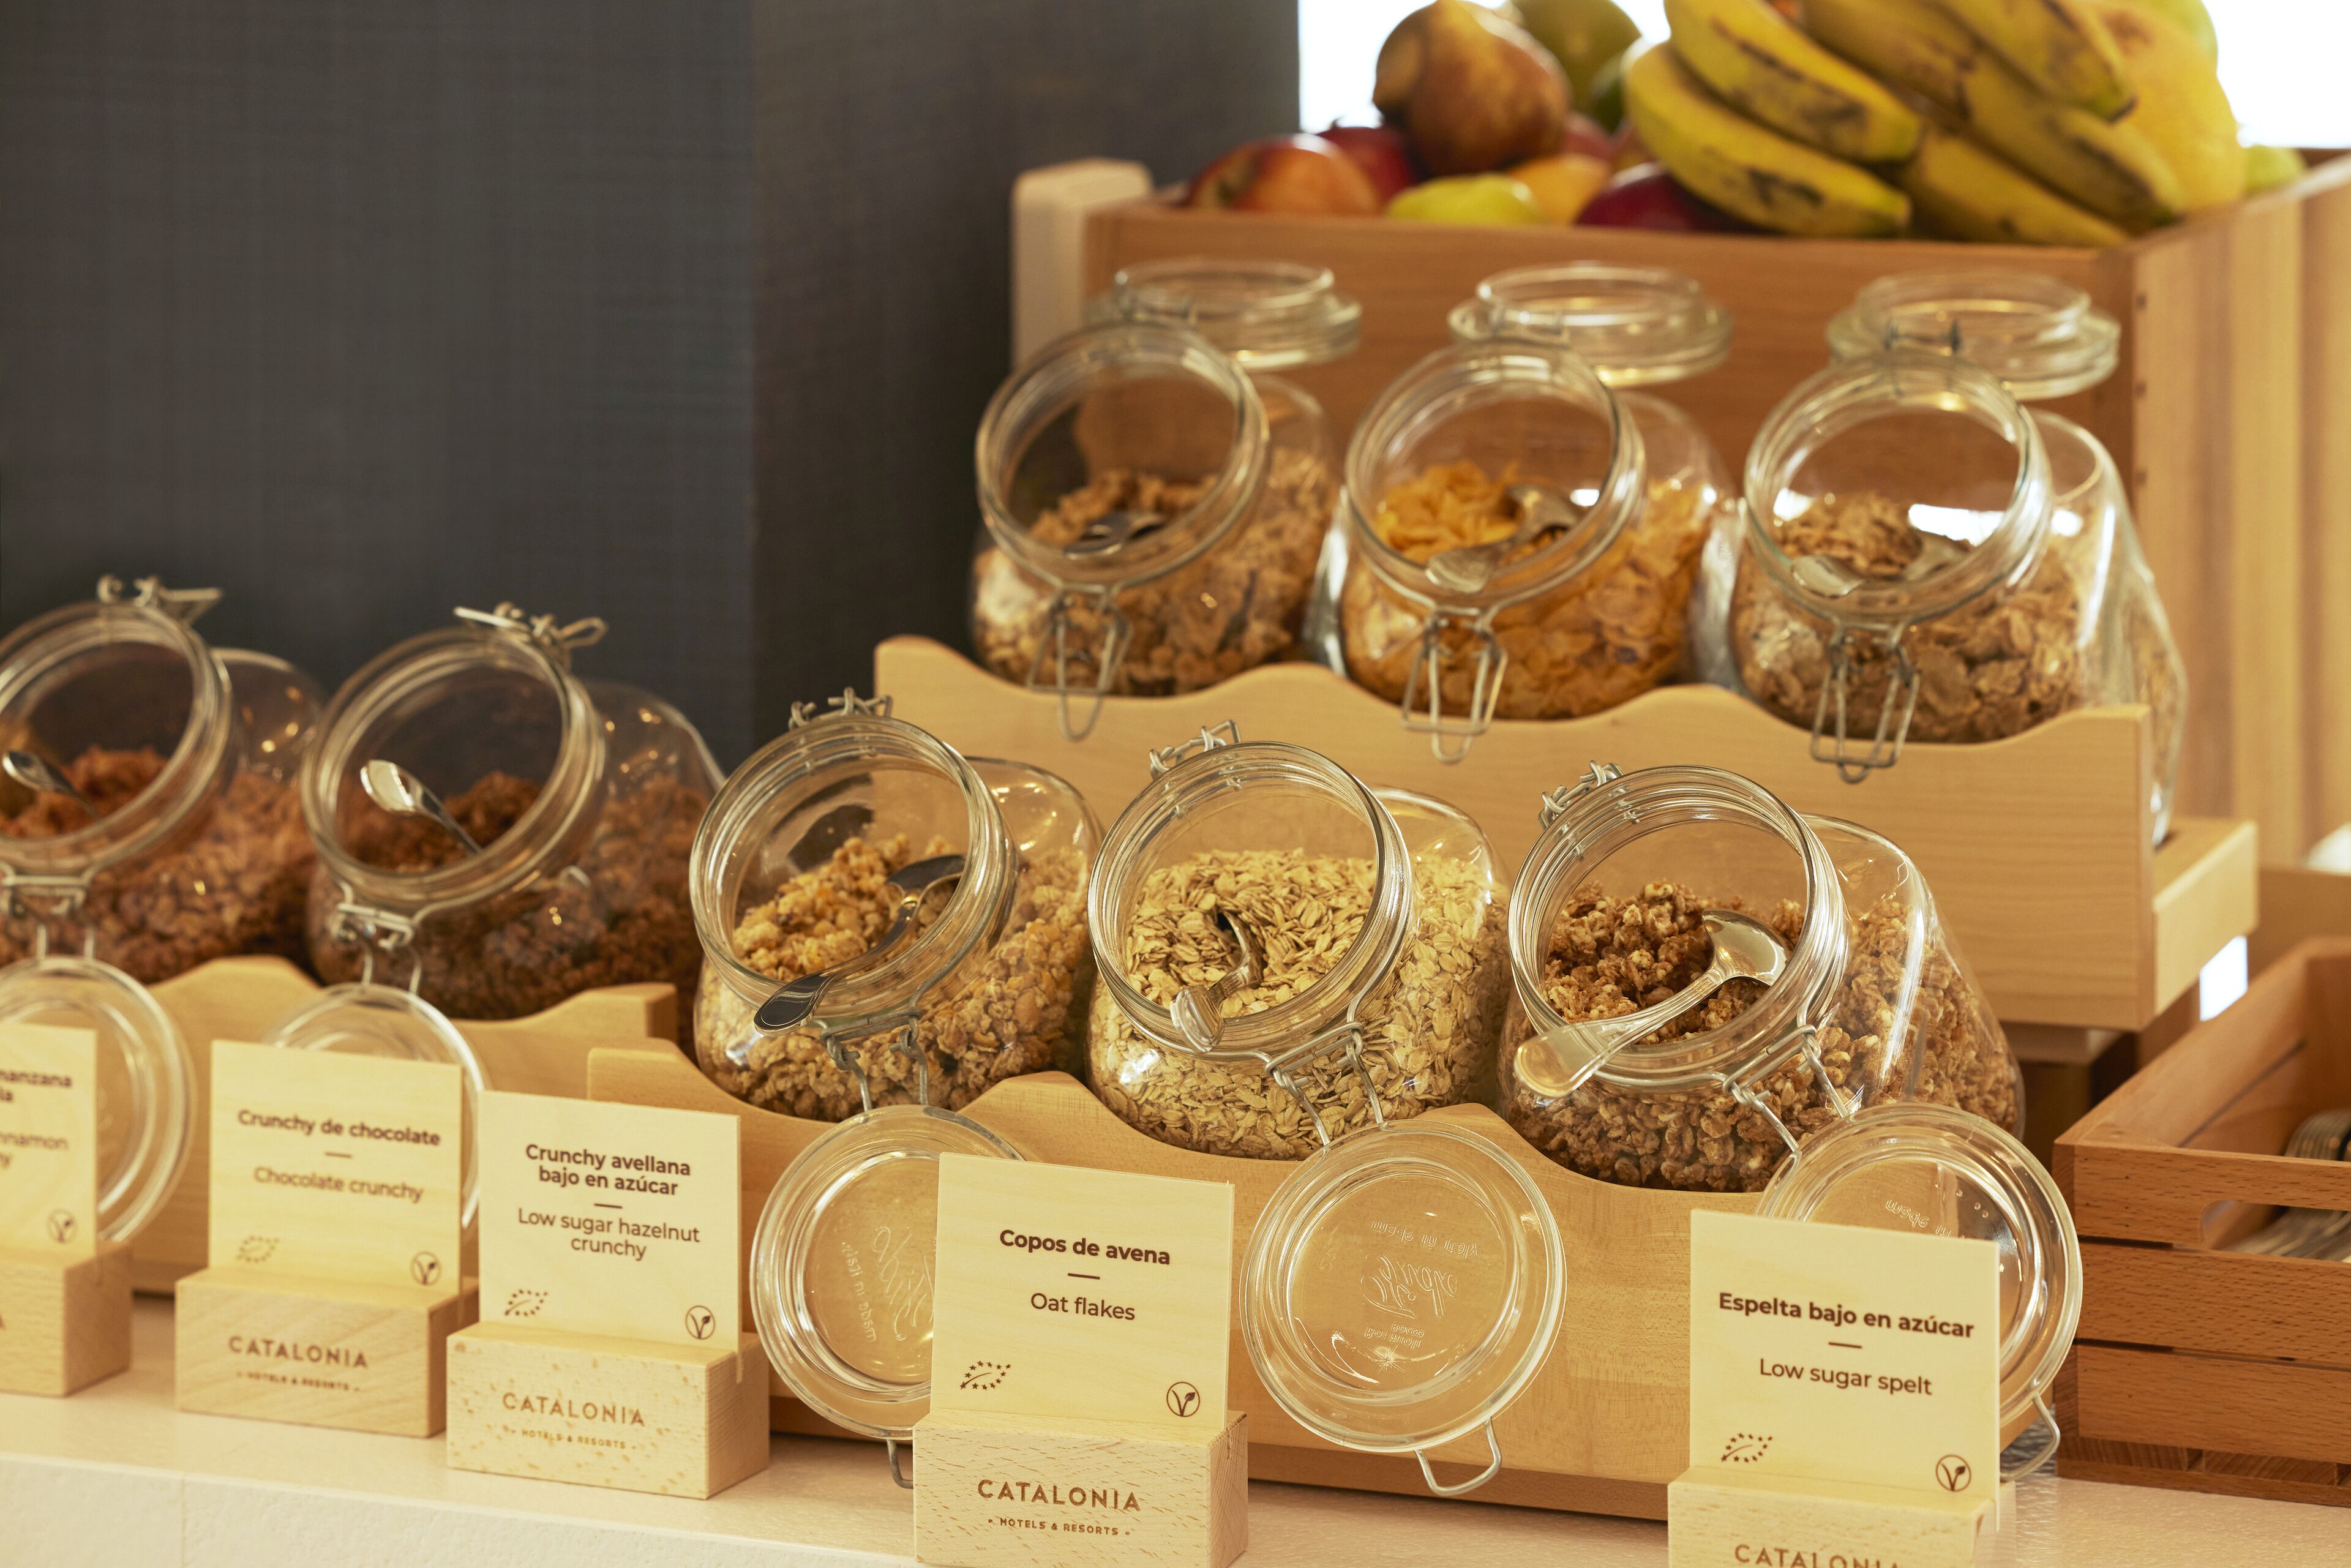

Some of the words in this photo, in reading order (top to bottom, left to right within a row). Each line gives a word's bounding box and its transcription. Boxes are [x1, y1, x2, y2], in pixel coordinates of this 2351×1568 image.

[0, 1070, 72, 1089] anzana
[238, 1109, 316, 1136] Crunchy
[320, 1119, 344, 1136] de
[348, 1123, 441, 1146] chocolate
[525, 1144, 606, 1171] Crunchy
[611, 1155, 691, 1176] avellana
[253, 1166, 345, 1192] Chocolate
[348, 1180, 424, 1204] crunchy
[539, 1165, 580, 1188] bajo
[585, 1174, 609, 1188] en
[614, 1175, 678, 1195] azúcar
[518, 1207, 556, 1226] Low
[560, 1215, 613, 1236] sugar
[617, 1217, 700, 1243] hazelnut
[571, 1237, 647, 1261] crunchy
[999, 1229, 1067, 1253] Copos
[1072, 1237, 1100, 1257] de
[1106, 1245, 1171, 1266] avena
[1030, 1292, 1068, 1313] Oat
[1074, 1296, 1135, 1321] flakes
[1719, 1292, 1802, 1318] Espelta
[1809, 1302, 1857, 1327] bajo
[1863, 1313, 1891, 1329] en
[1898, 1315, 1974, 1338] azúcar
[228, 1335, 368, 1368] CATALONIA
[1760, 1358, 1804, 1379] Low
[1810, 1368, 1872, 1389] sugar
[1878, 1376, 1932, 1395] spelt
[502, 1392, 645, 1427] CATALONIA
[522, 1430, 563, 1442] HOTELS
[577, 1436, 626, 1449] RESORTS
[977, 1479, 1141, 1512] CATALONIA
[999, 1517, 1046, 1530] HOTELS
[1051, 1522, 1059, 1531] &
[1063, 1522, 1119, 1536] RESORTS
[1734, 1544, 1900, 1568] CATALON
